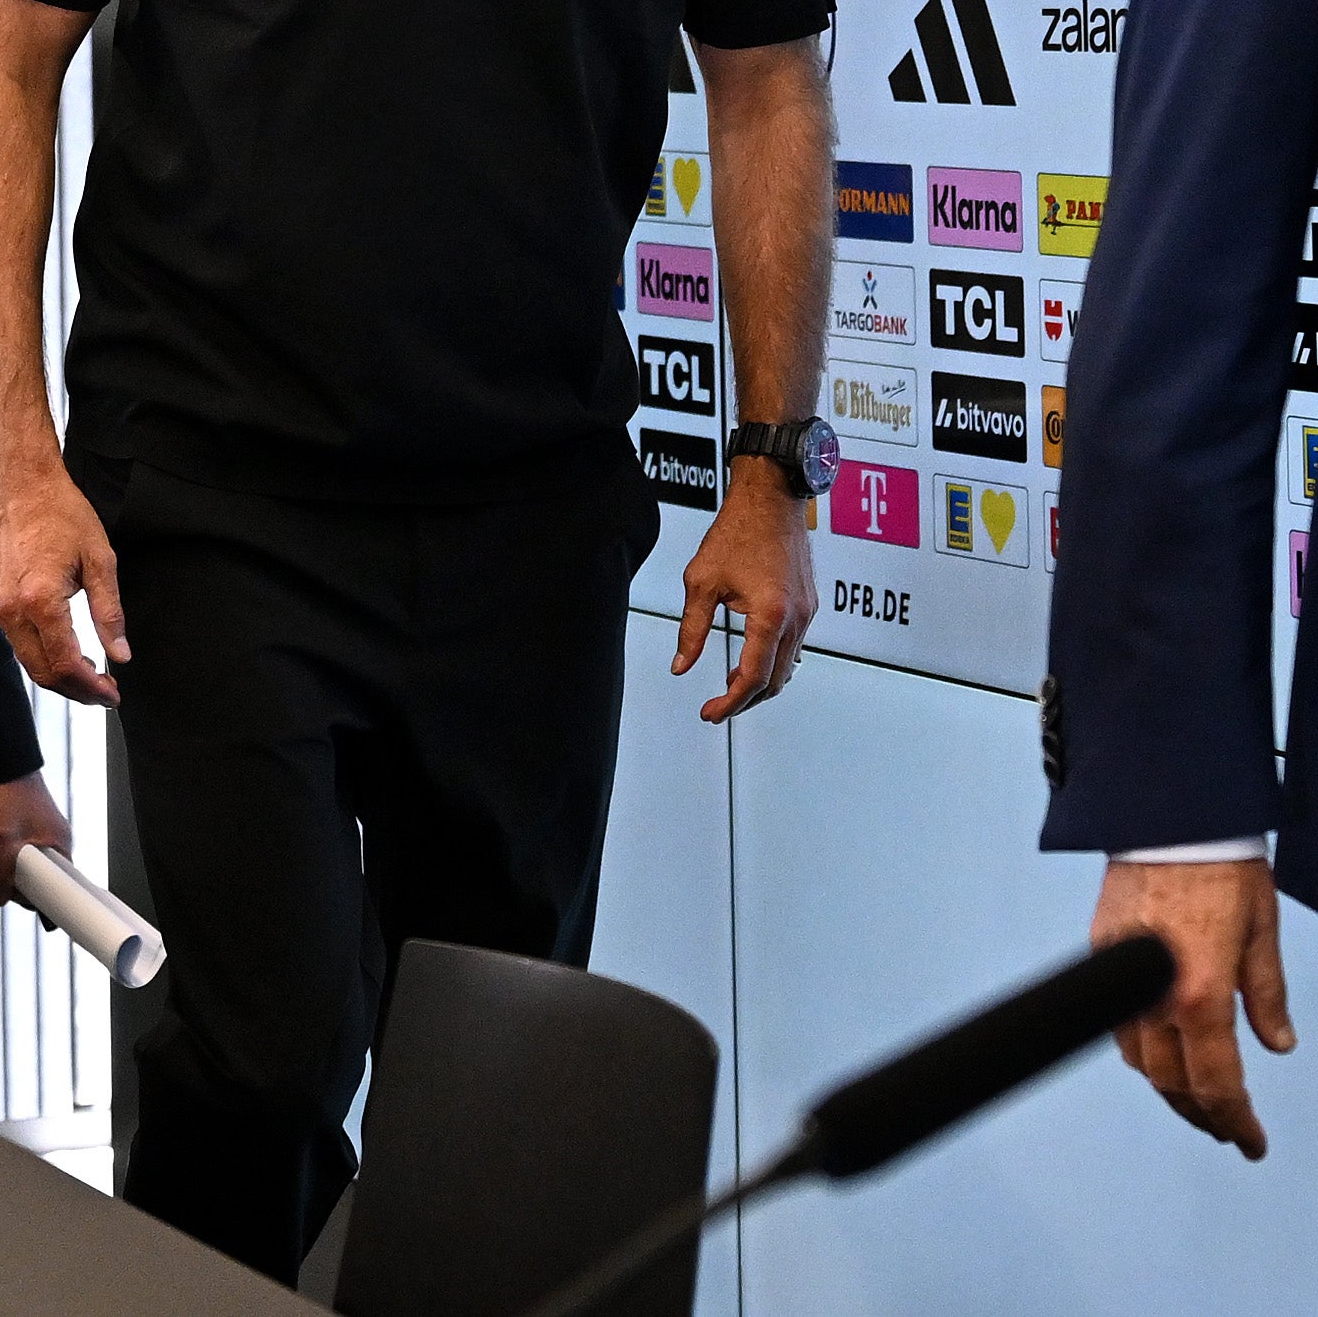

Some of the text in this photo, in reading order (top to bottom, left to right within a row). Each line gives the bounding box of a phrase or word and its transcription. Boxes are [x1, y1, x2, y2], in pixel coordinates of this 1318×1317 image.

[838, 188, 911, 216] ÖRMANN
[932, 184, 1018, 234] Klarna
[1066, 199, 1104, 222] PAN
[640, 258, 710, 305] Klarna
[834, 310, 908, 337] TARGOBANK
[935, 284, 1019, 343] TCL
[643, 349, 711, 405] TCL
[849, 379, 912, 432] Bitburger
[956, 398, 1025, 438] bitvavo
[659, 453, 716, 490] bitvavo
[834, 580, 911, 626] DFB.DE
